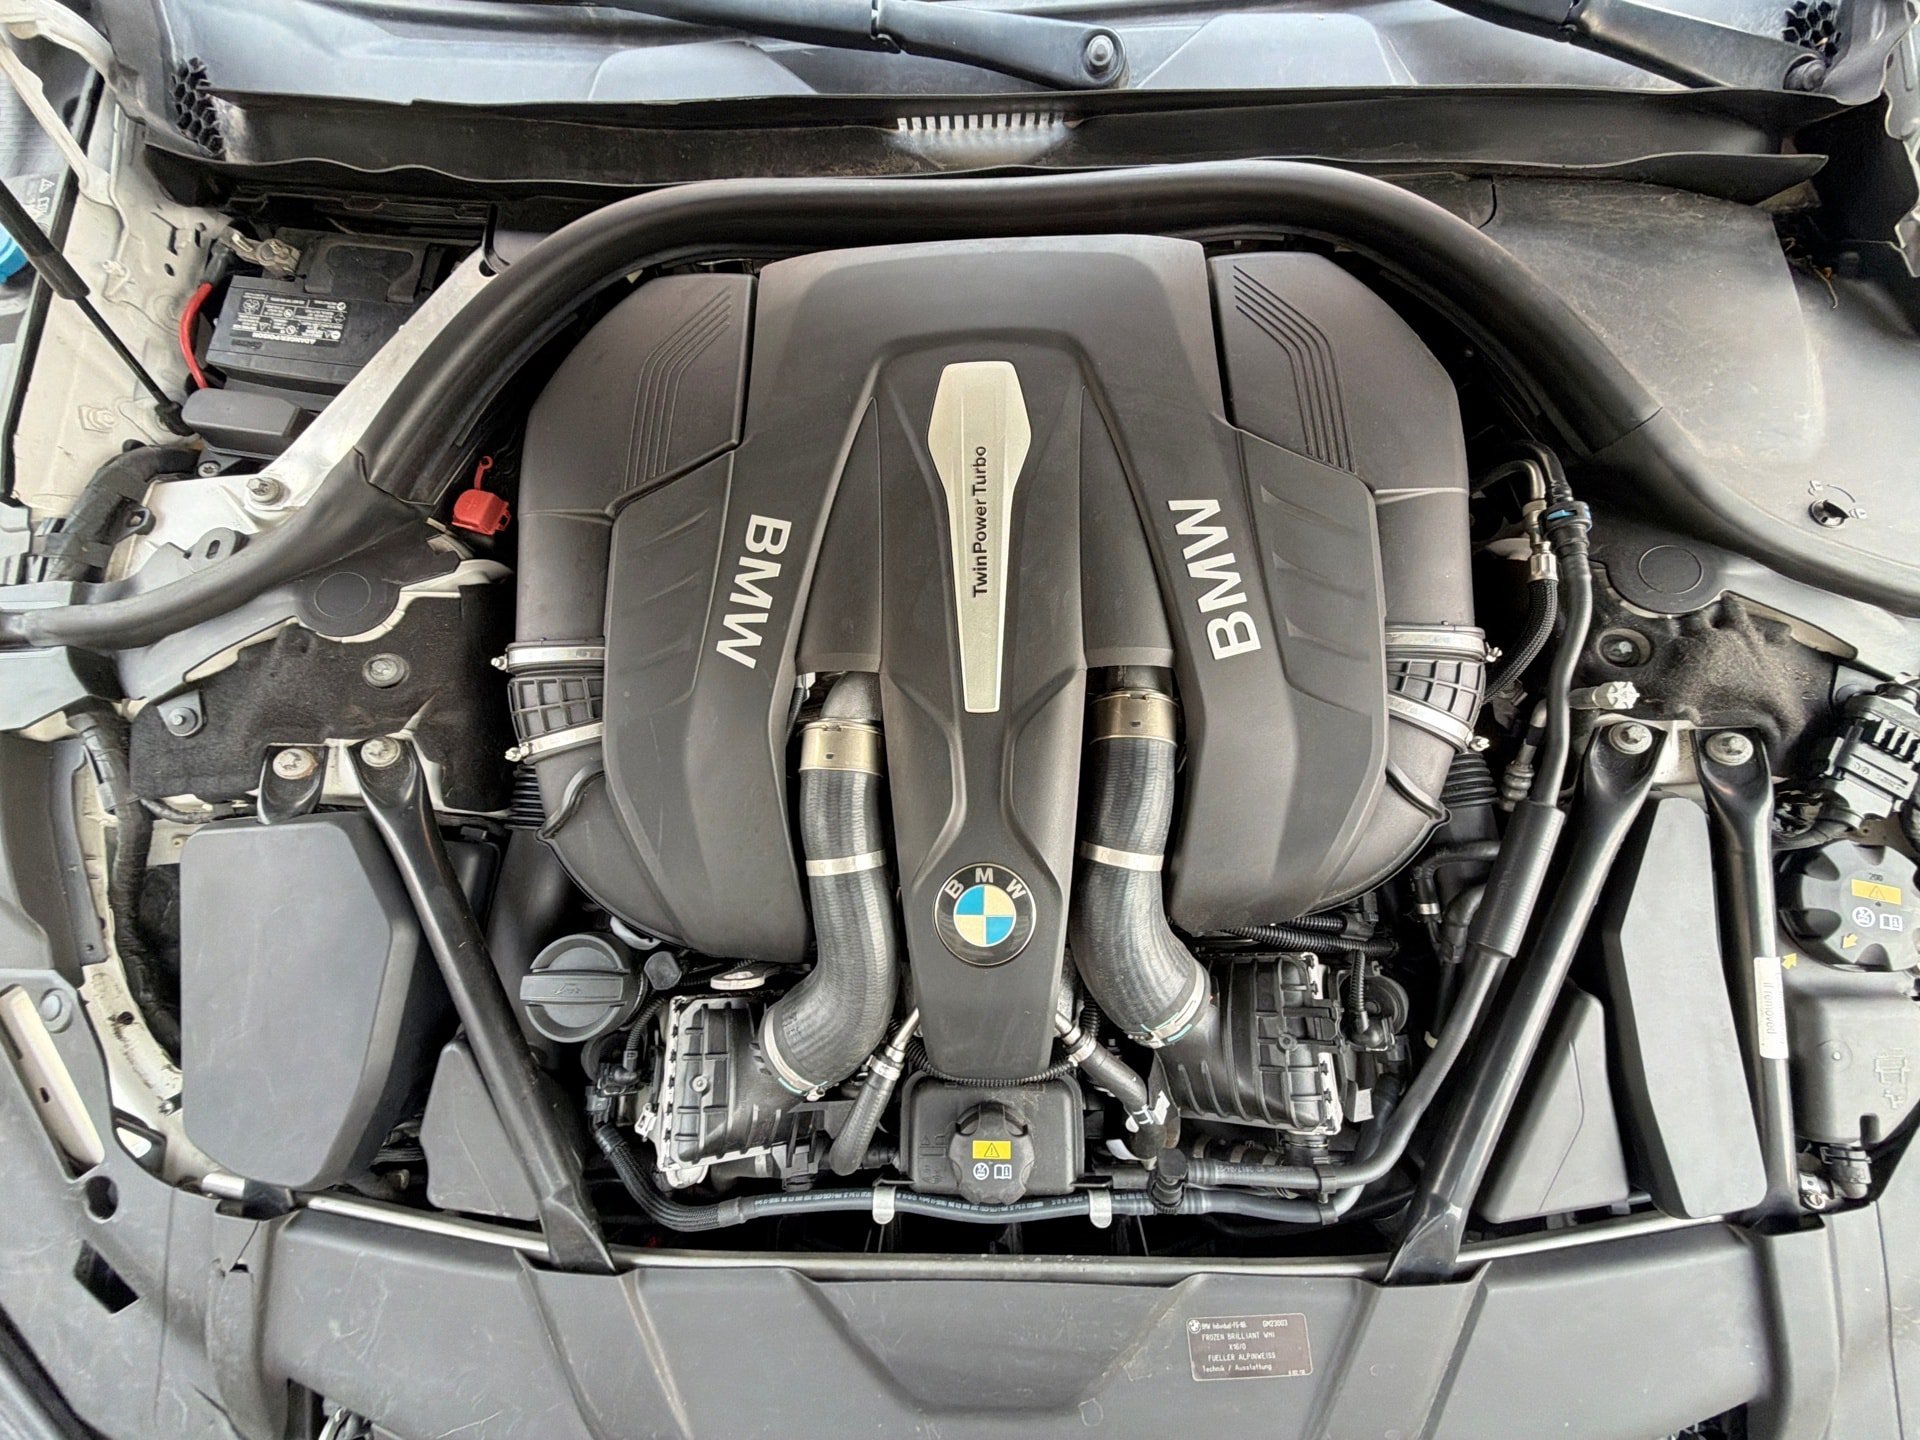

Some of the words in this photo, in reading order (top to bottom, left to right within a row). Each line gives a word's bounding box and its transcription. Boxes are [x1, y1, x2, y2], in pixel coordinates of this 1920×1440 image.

[972, 446, 987, 496] Turbo
[972, 499, 988, 598] TwinPower
[716, 514, 792, 669] BMW
[1168, 499, 1262, 660] BMW
[943, 867, 1026, 899] BMW
[1202, 1333, 1225, 1341] FROZEN
[1227, 1332, 1260, 1341] BRILLIANT
[1208, 1353, 1235, 1362] FUELLER
[1238, 1352, 1276, 1361] ALPINWEISS
[1234, 1363, 1273, 1372] Ausstattung
